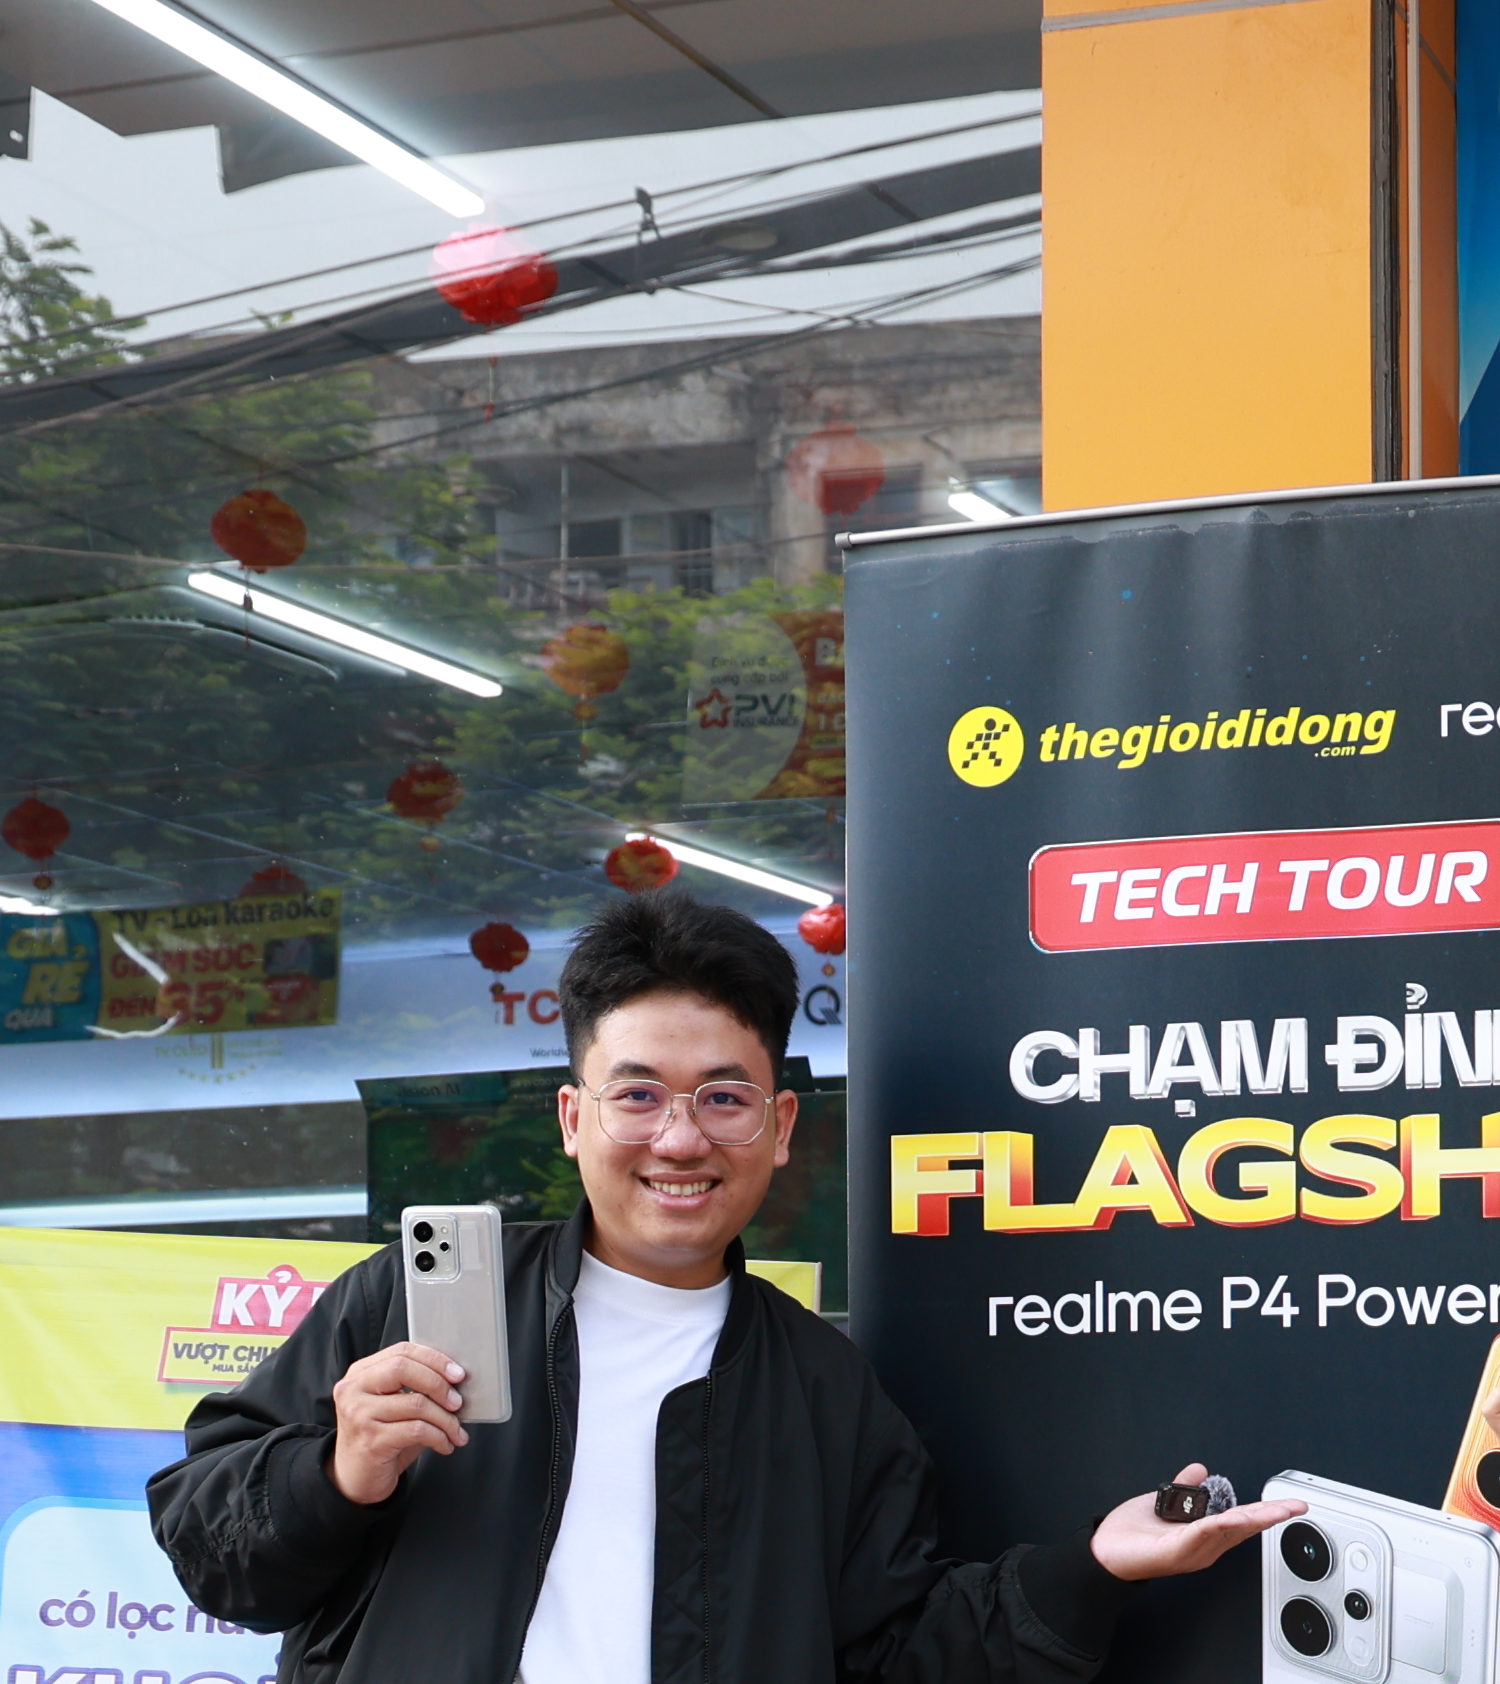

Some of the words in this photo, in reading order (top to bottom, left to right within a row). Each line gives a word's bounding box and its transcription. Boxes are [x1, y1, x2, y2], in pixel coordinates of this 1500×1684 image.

[1039, 704, 1396, 770] thegioididong
[1070, 860, 1259, 923] TECH
[1278, 850, 1489, 912] TOUR
[1009, 1014, 1308, 1119] CHẠM
[218, 1270, 302, 1327] KỶ
[988, 1277, 1203, 1338] realme
[1221, 1273, 1301, 1331] P4
[39, 1590, 96, 1631] có
[106, 1591, 175, 1640] lọc
